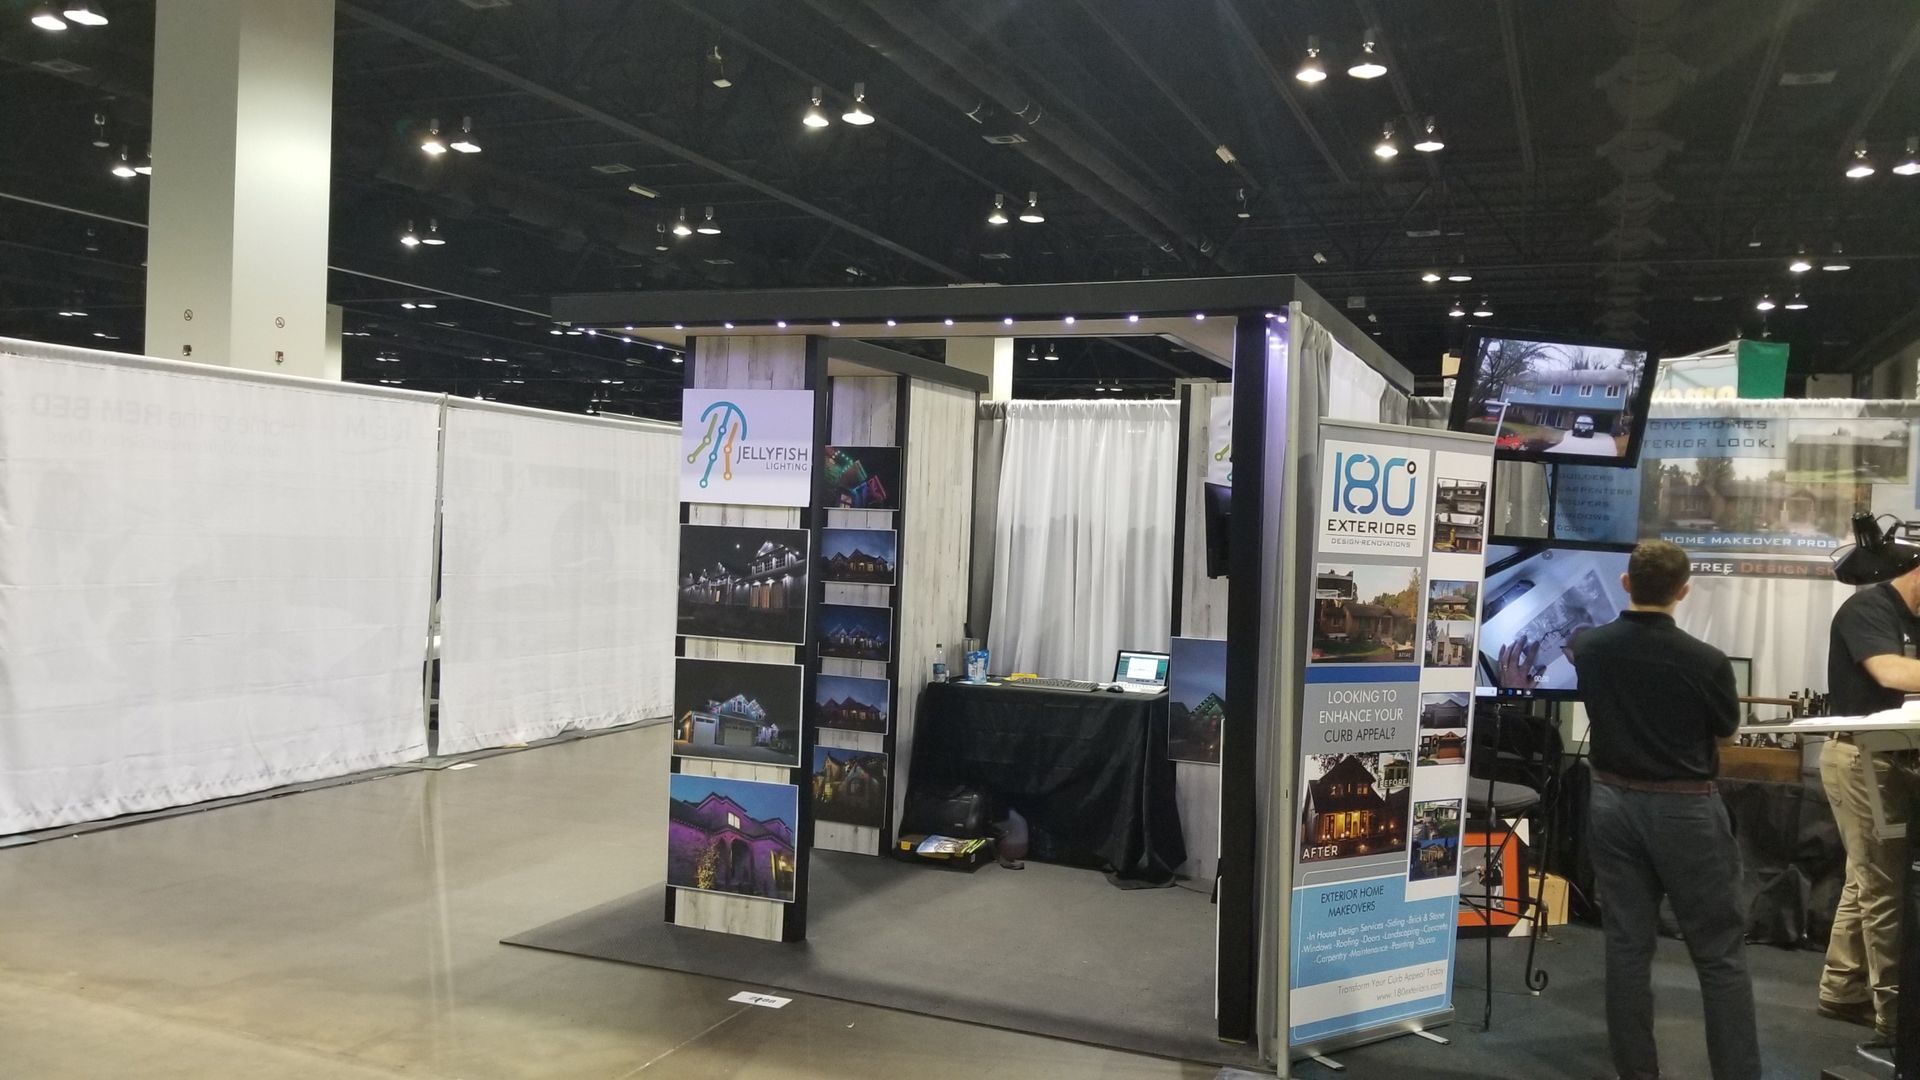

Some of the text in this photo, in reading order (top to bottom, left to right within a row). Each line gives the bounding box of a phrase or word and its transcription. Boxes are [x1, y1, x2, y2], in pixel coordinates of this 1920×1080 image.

[1650, 420, 1768, 430] GIVE HOMES
[1716, 438, 1775, 448] LOOK.
[737, 445, 808, 464] JELLYFISH
[766, 462, 807, 472] LIGHTING
[1327, 519, 1416, 535] EXTERIORS
[1664, 536, 1838, 548] HOME MAKEOVER PROS
[1690, 562, 1733, 573] FREE
[1328, 689, 1397, 704] LOOKING TO
[1319, 708, 1403, 724] ENHANCE YOUR
[1323, 726, 1396, 743] CURB APPEAL?
[1379, 778, 1407, 787] BEFORE
[1302, 845, 1338, 860] AFTER
[1320, 885, 1385, 904] EXTERIOR HOME
[1328, 900, 1376, 917] MAKEOVERS
[1316, 929, 1337, 940] House
[1338, 926, 1360, 937] Design
[1360, 923, 1384, 933] Services
[1429, 912, 1445, 921] Stone
[1337, 982, 1370, 995] Transform
[1371, 977, 1386, 988] Your
[1387, 975, 1403, 985] Curb
[1404, 969, 1424, 982] Appeal
